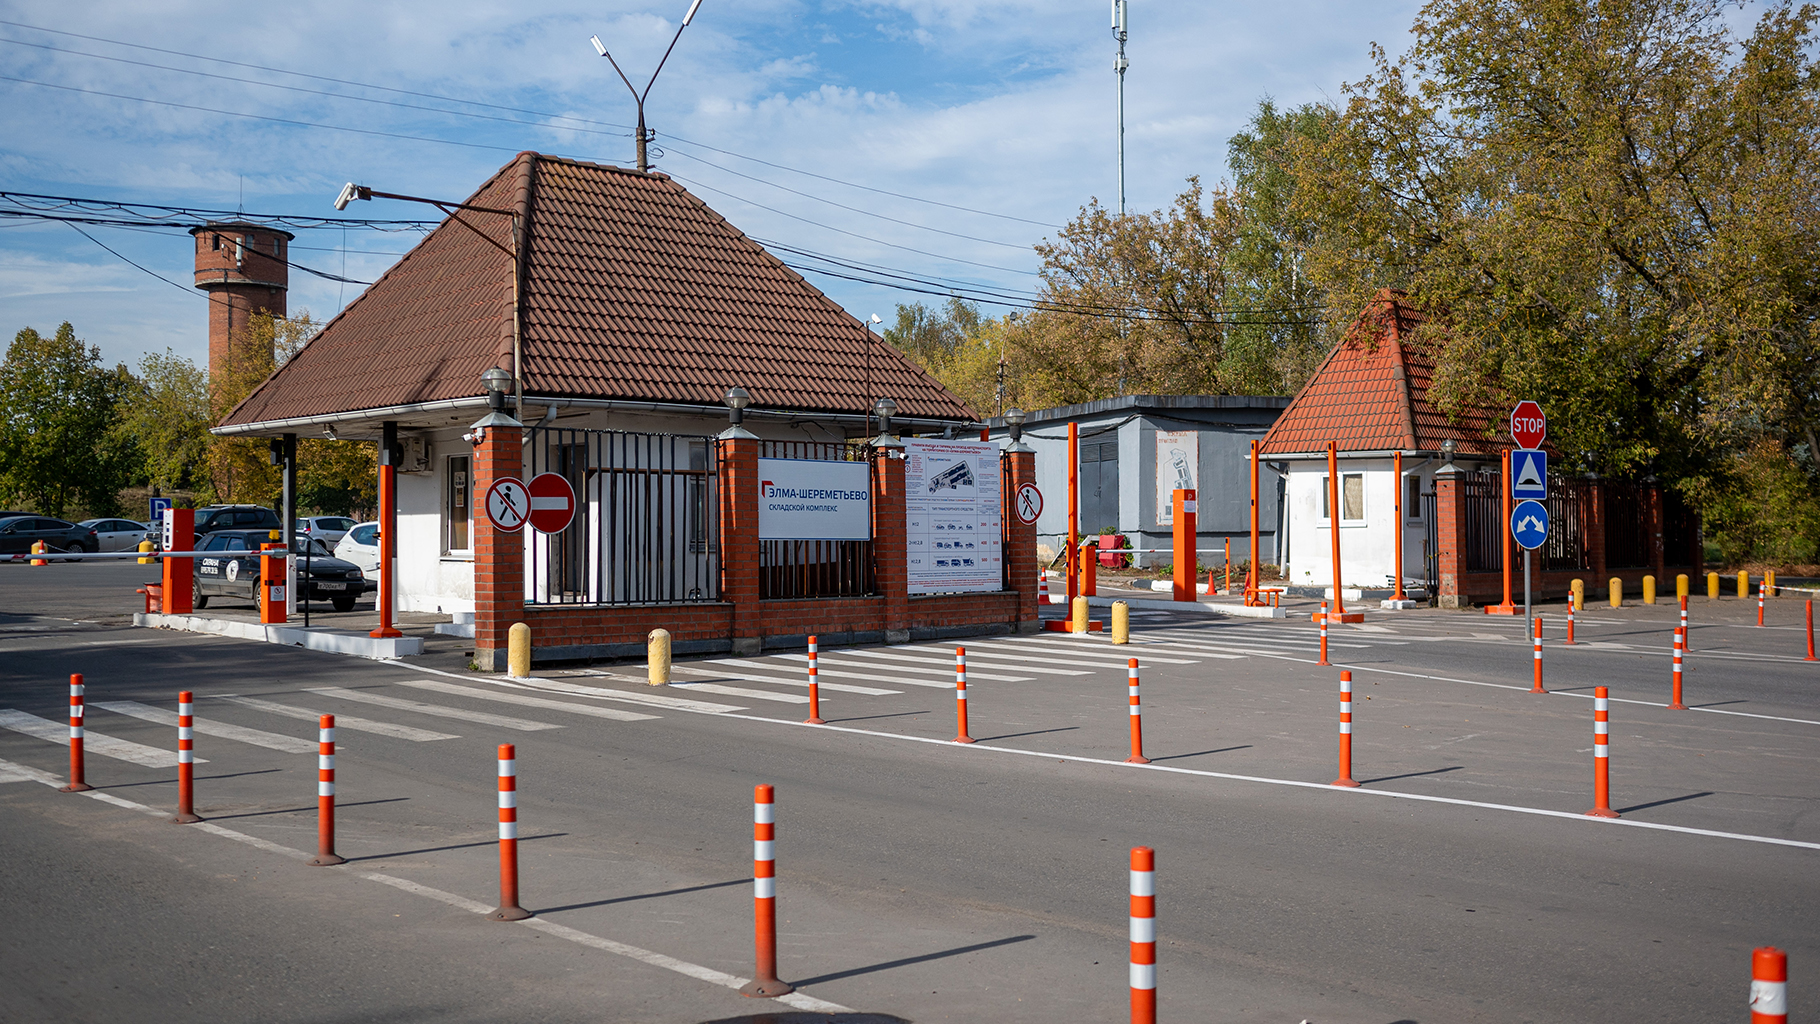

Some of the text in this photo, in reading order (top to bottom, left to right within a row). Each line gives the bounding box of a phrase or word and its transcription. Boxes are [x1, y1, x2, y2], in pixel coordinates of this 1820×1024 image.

[1514, 417, 1544, 433] STOP
[768, 487, 868, 501] ЭЛМА-ШЕРЕМЕТЬЕВО
[155, 500, 167, 518] P
[768, 503, 838, 512] СКЛАДСКОЙ КОМПЛЕКС
